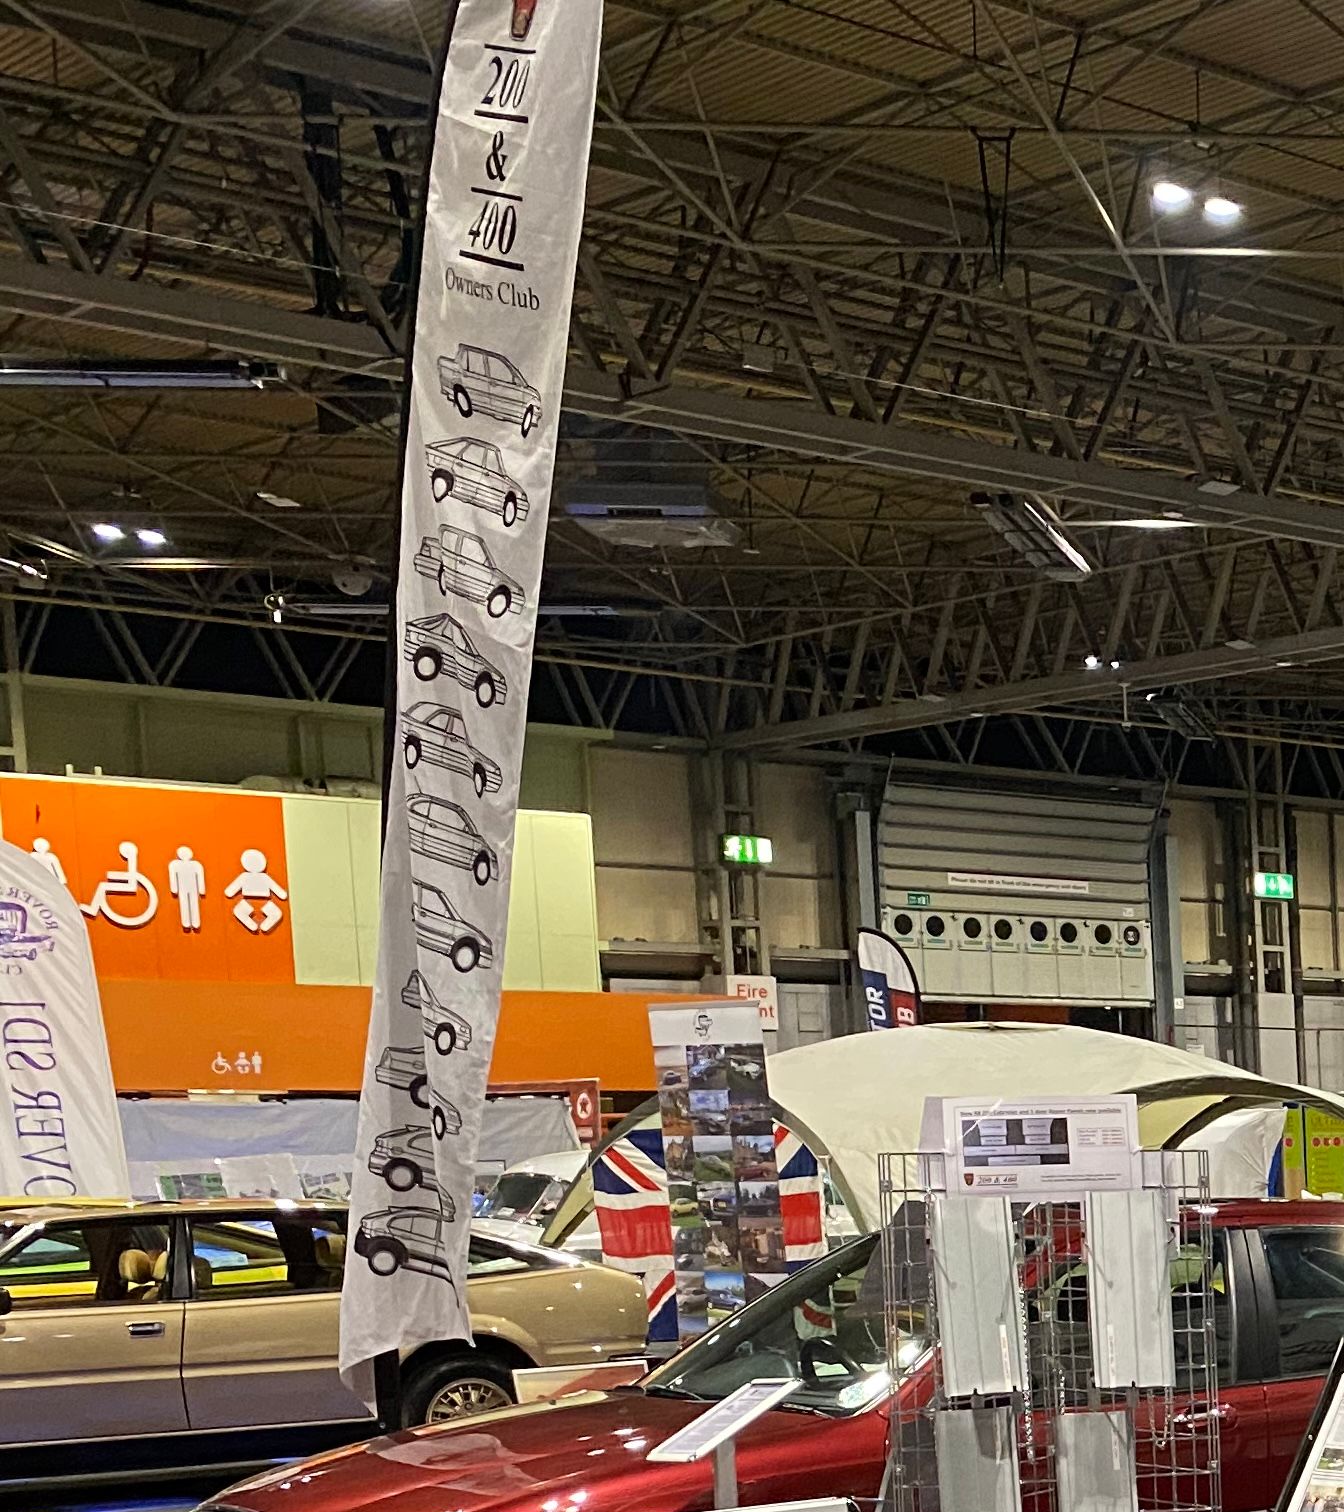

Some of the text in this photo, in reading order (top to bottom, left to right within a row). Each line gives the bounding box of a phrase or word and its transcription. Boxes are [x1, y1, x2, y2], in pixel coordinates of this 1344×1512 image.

[481, 56, 531, 109] 200
[485, 130, 507, 183] &
[468, 202, 518, 256] 400
[445, 267, 541, 312] Owners Club
